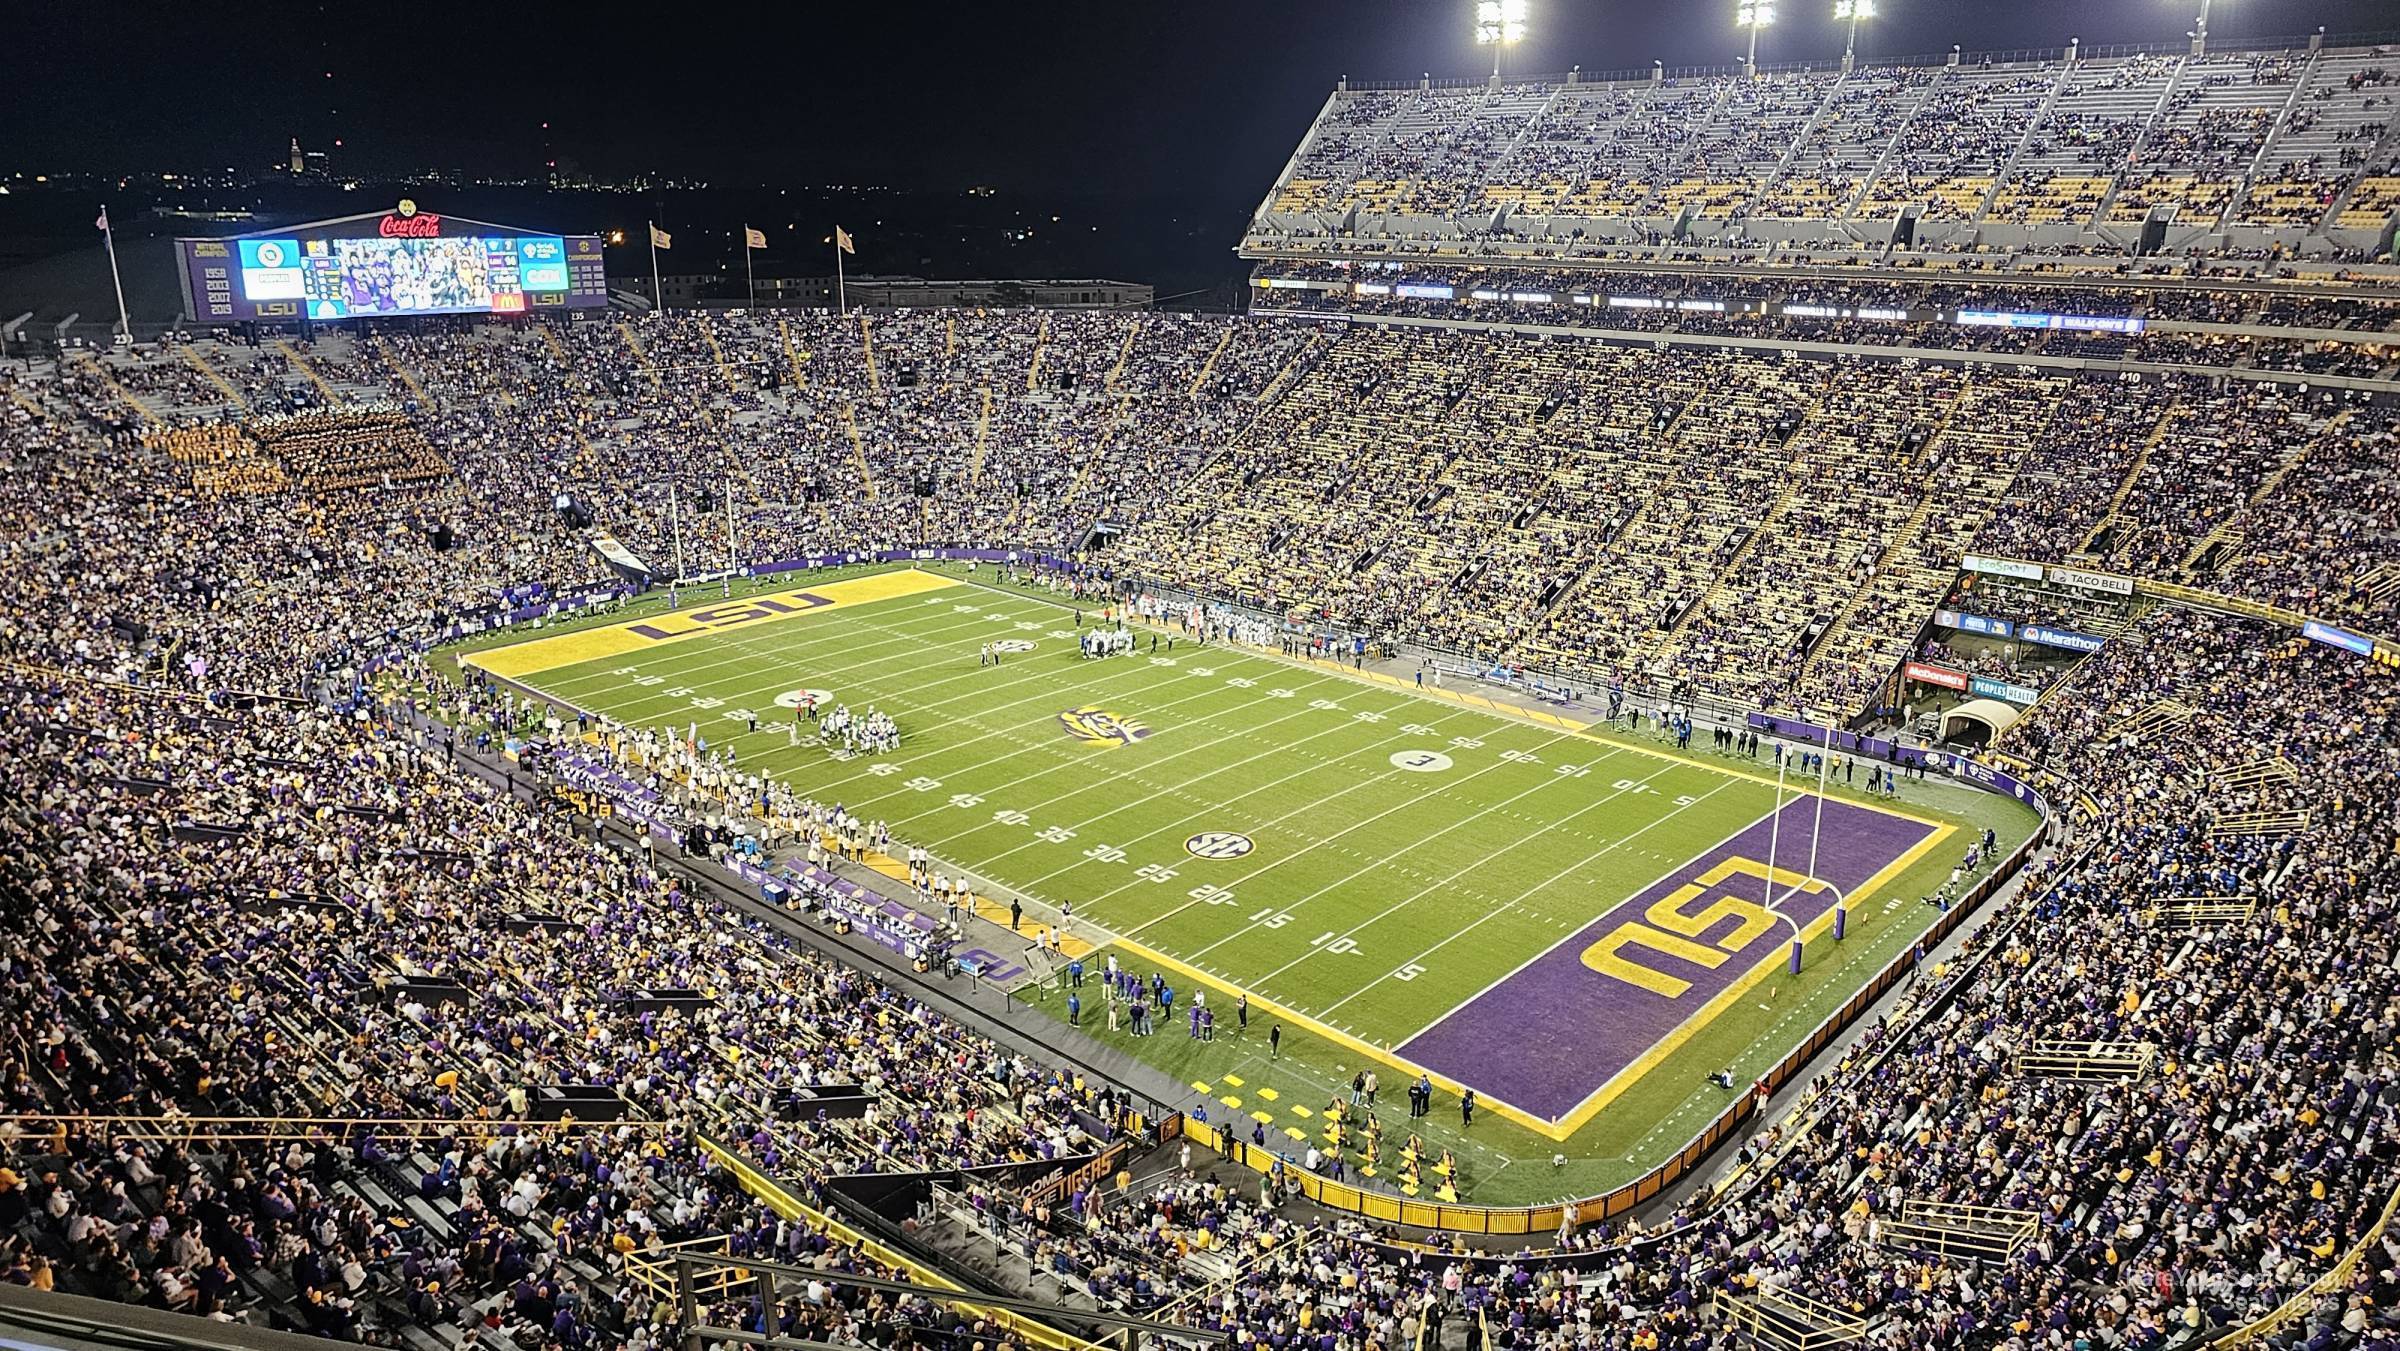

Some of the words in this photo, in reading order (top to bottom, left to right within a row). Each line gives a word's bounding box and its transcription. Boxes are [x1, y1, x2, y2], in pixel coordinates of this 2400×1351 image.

[379, 215, 440, 238] Coca-Cola
[204, 267, 227, 279] 1958
[206, 279, 230, 291] 2003
[208, 291, 231, 303] 2007
[531, 293, 565, 306] LSU
[211, 303, 233, 315] 2019
[256, 302, 298, 317] LSU
[571, 312, 585, 321] 235
[1780, 349, 1798, 359] 304
[1900, 357, 1919, 367] 305
[2016, 364, 2038, 375] 306
[2118, 371, 2142, 384] 410
[1977, 558, 2027, 573] EcoSport
[2071, 574, 2099, 587] TACO
[2101, 578, 2128, 592] BELL
[625, 593, 836, 639] LSU
[2040, 630, 2102, 651] Marathon
[613, 666, 638, 676] 5
[1908, 666, 1965, 687] McDonald's
[662, 686, 695, 697] 15
[1975, 680, 2006, 697] PEOPLES
[2007, 687, 2036, 703] HEALTH
[690, 697, 726, 709] 20
[1448, 736, 1486, 749] 25
[1499, 749, 1539, 763] 20
[866, 763, 902, 777] 45
[1553, 764, 1592, 778] 15
[903, 776, 943, 792] 50
[1611, 779, 1650, 794] 10
[948, 793, 986, 809] 45
[1671, 795, 1697, 806] 5
[992, 810, 1030, 826] 40
[1034, 825, 1078, 844] 35
[1082, 843, 1127, 863] 30
[1187, 832, 1251, 859] SEC
[1133, 863, 1181, 884] 25
[1187, 884, 1236, 906] 20
[1248, 907, 1296, 930] 15
[1579, 855, 1828, 999] LSU
[1310, 931, 1359, 954] 10
[1393, 963, 1428, 983] 5
[1057, 1144, 1126, 1202] TIGERS
[1020, 1166, 1064, 1199] COME
